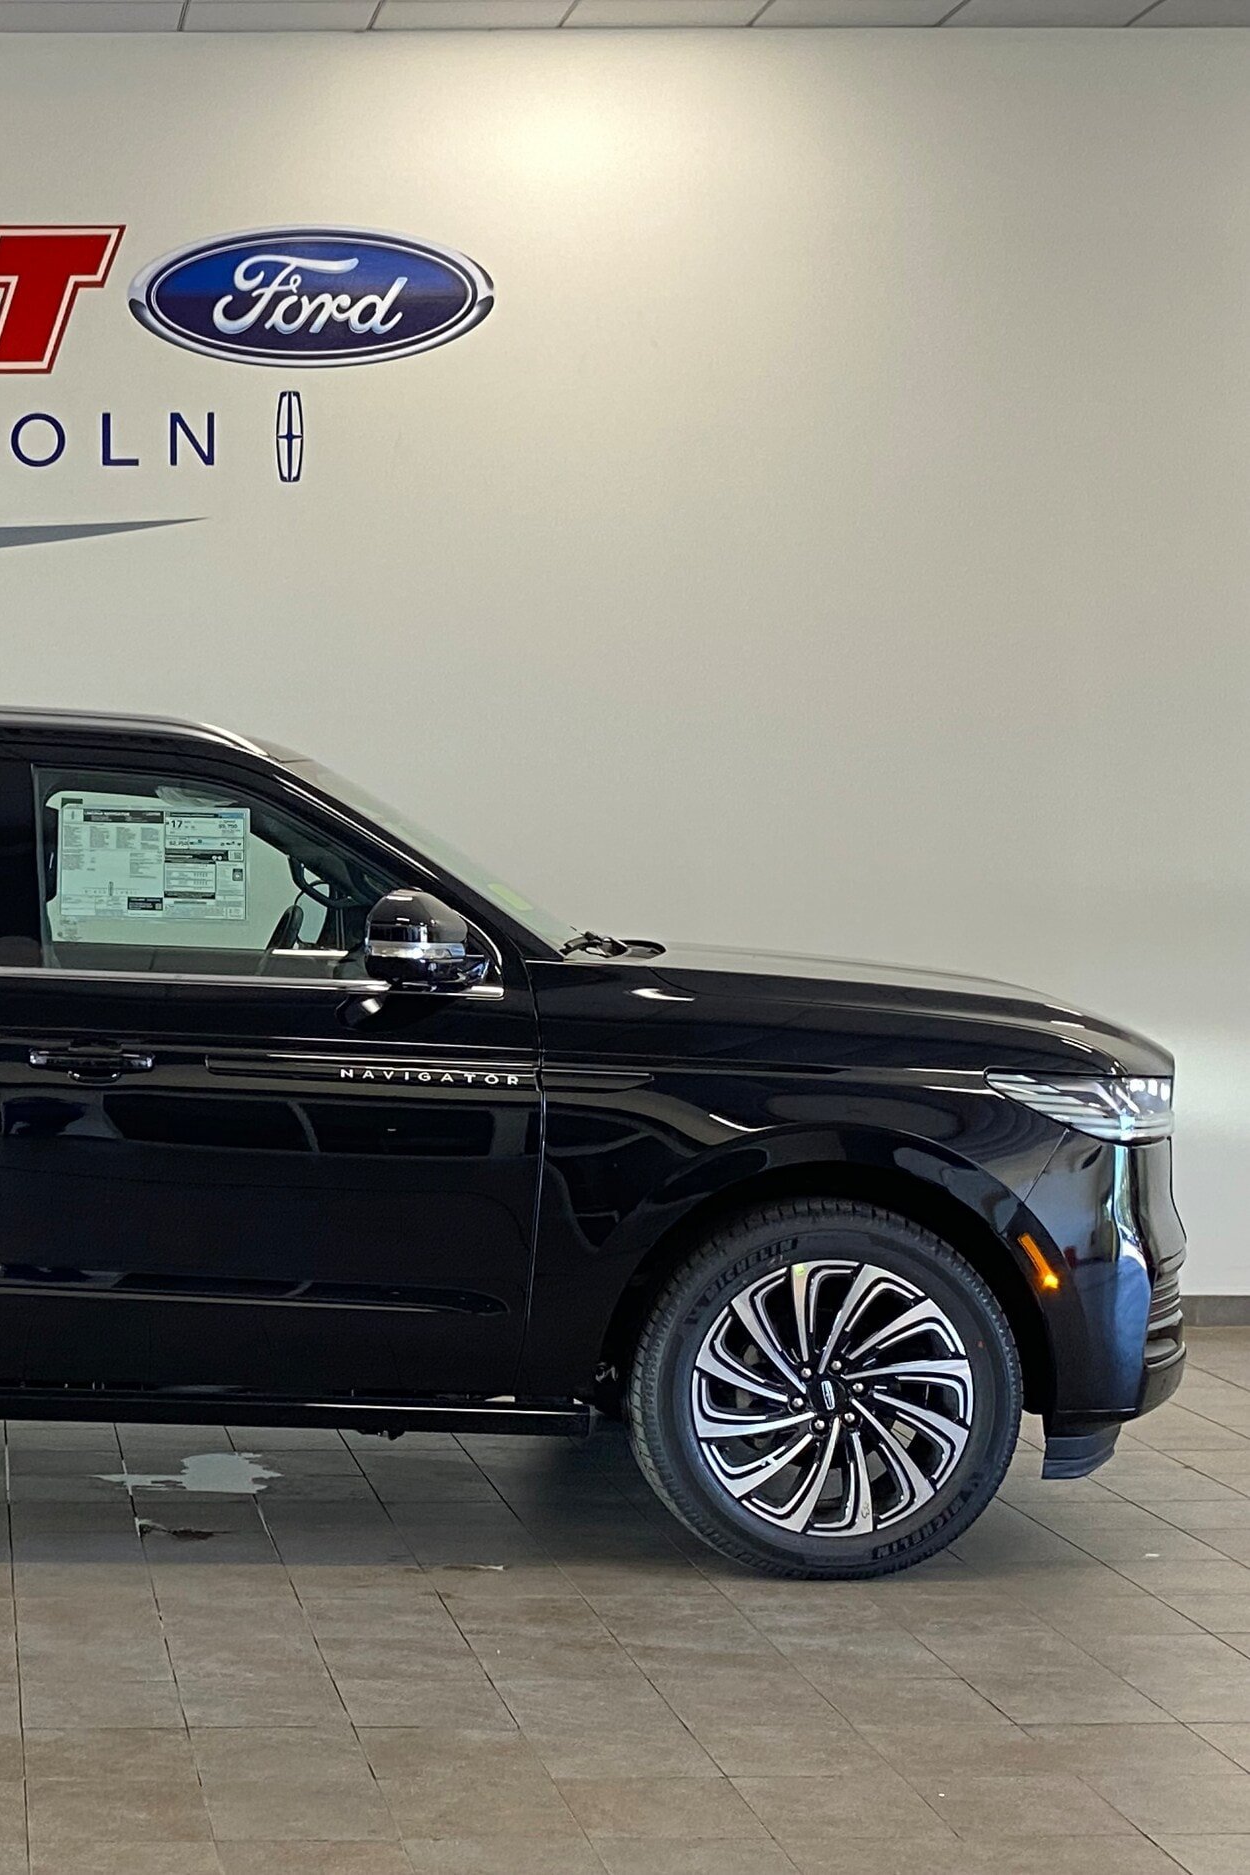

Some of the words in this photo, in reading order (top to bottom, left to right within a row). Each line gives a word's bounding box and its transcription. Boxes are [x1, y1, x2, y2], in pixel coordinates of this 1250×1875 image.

[212, 254, 409, 335] Ford
[340, 1068, 519, 1086] NAVIGATOR
[875, 1495, 964, 1559] MICHELIN
